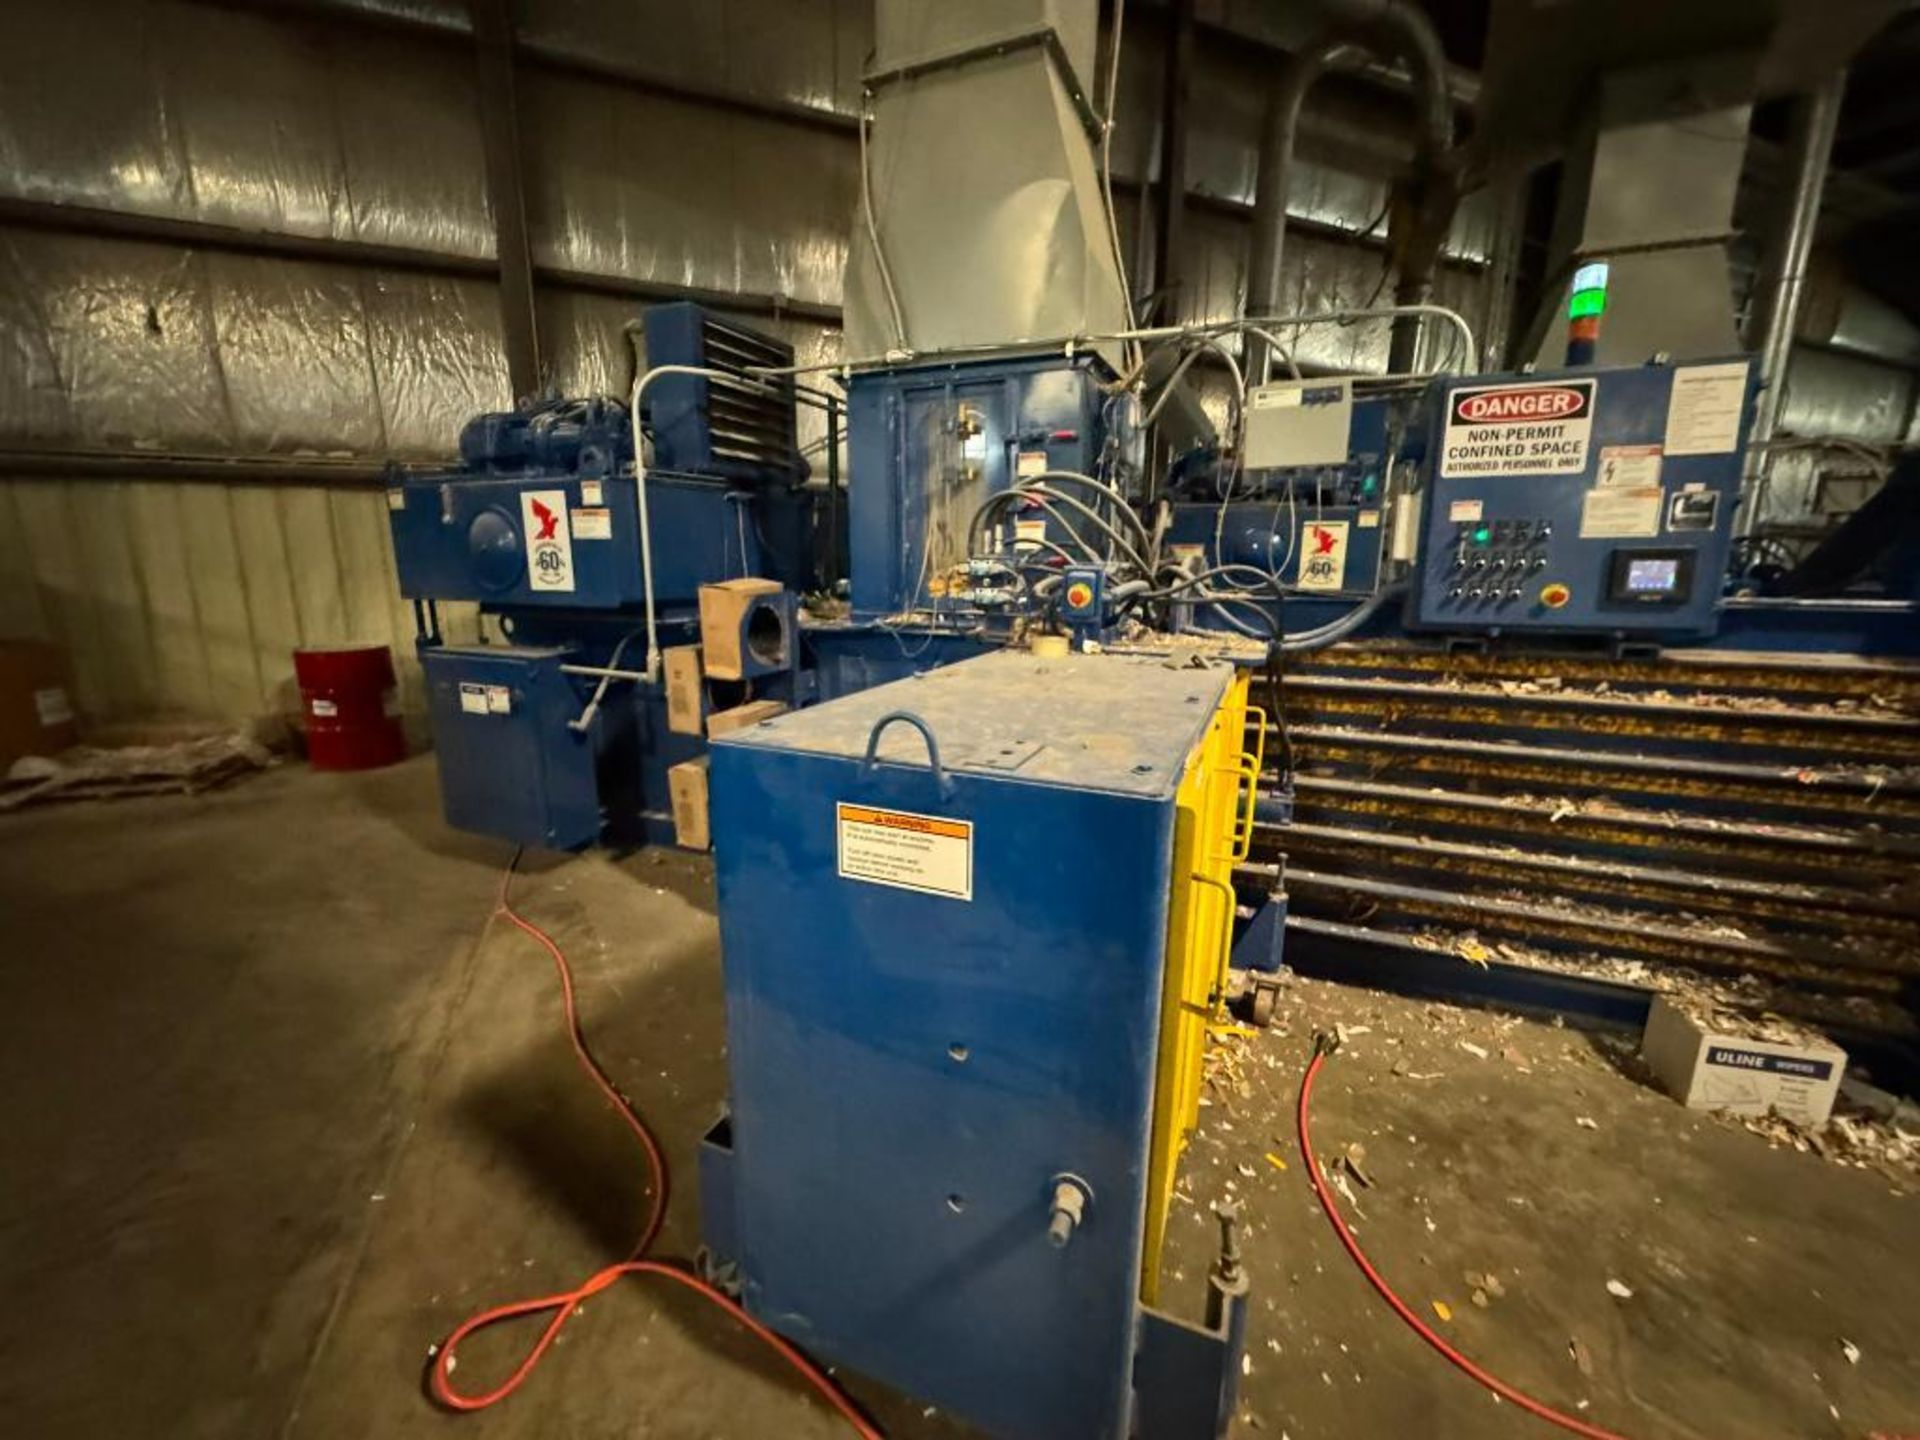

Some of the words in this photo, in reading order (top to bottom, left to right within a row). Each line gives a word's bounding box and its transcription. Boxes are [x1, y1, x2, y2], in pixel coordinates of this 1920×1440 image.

[1471, 394, 1570, 417] DANGER
[1468, 425, 1565, 442] NON-PERMIT
[1449, 444, 1525, 459] CONFINED
[1530, 440, 1582, 455] SPACE
[1447, 461, 1499, 472] AUTHORIZED
[1502, 459, 1552, 470] PERSONNEL
[1558, 457, 1580, 467] ONLY
[539, 550, 560, 571] 60
[1310, 561, 1331, 576] 60
[884, 814, 932, 830] WARNING
[1715, 1051, 1765, 1068] ULINE
